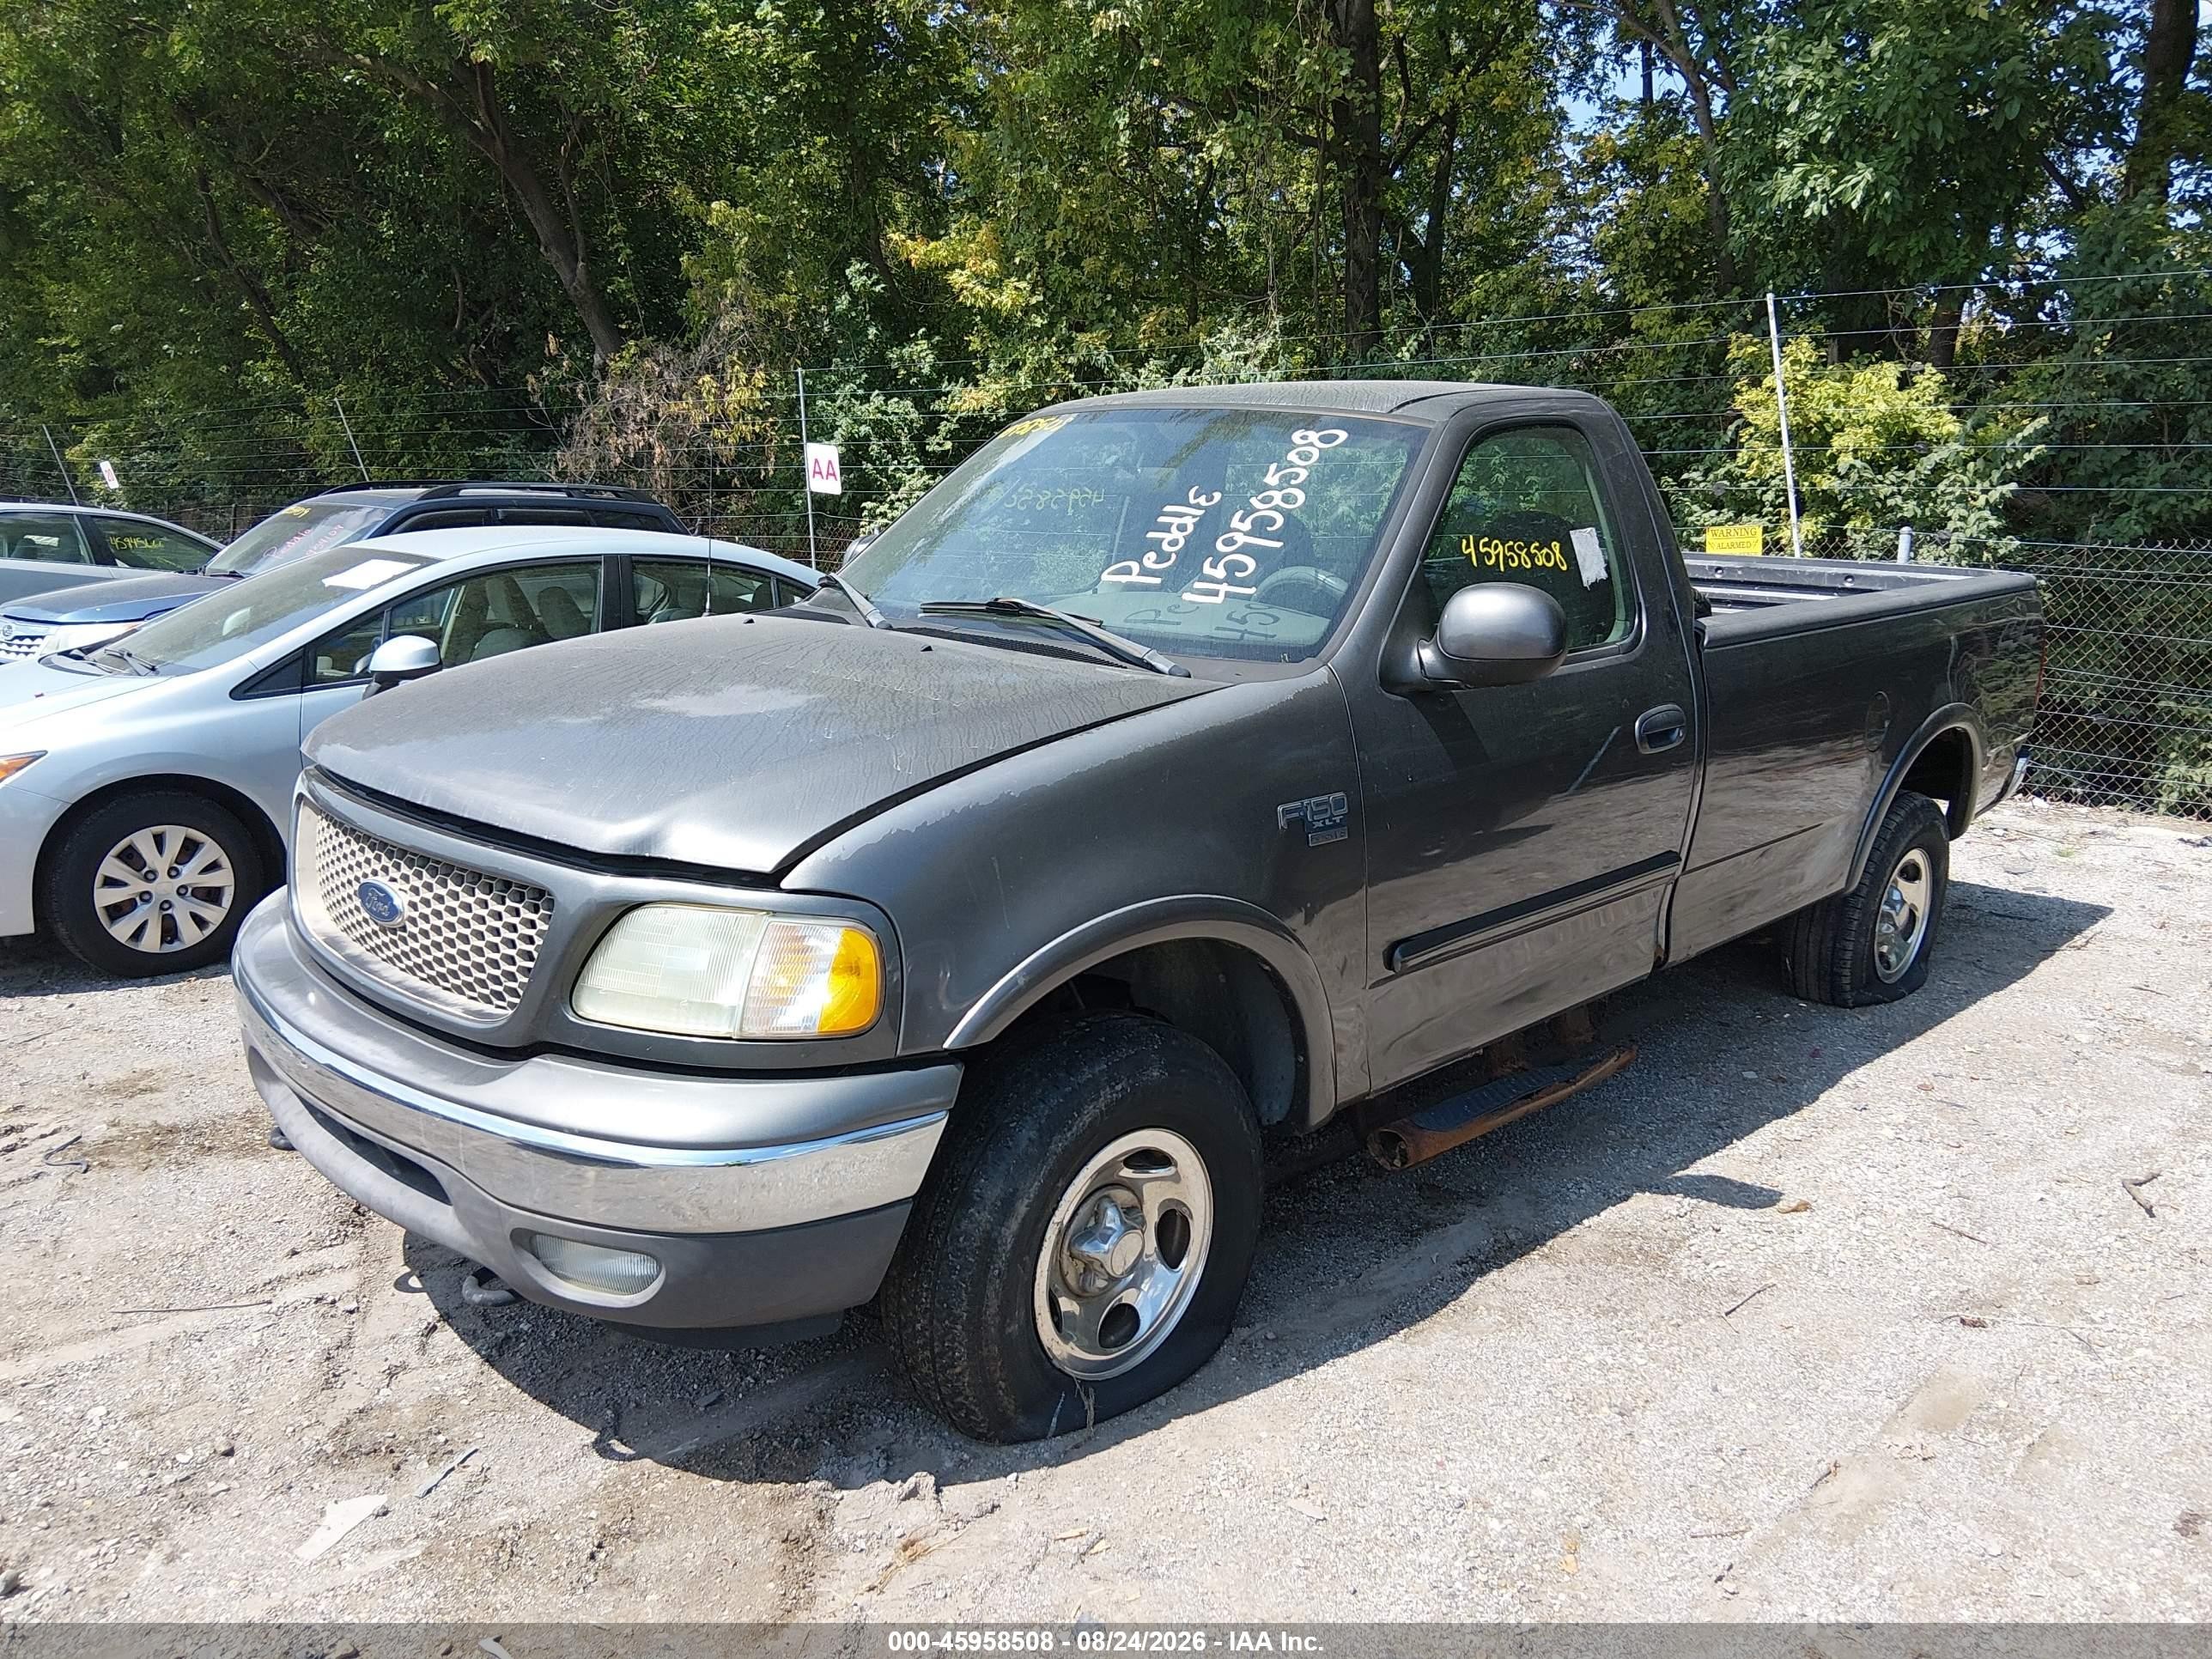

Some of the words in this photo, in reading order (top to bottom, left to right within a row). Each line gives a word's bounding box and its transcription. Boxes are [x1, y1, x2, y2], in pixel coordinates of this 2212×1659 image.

[812, 458, 837, 482] AA
[1181, 428, 1349, 604] 45958508
[1101, 485, 1222, 584] Peddle
[1711, 527, 1757, 538] WARNING
[1717, 541, 1752, 550] ALARMED
[1462, 534, 1568, 572] 45958508
[1313, 815, 1344, 829] XLT
[365, 887, 392, 916] Ford
